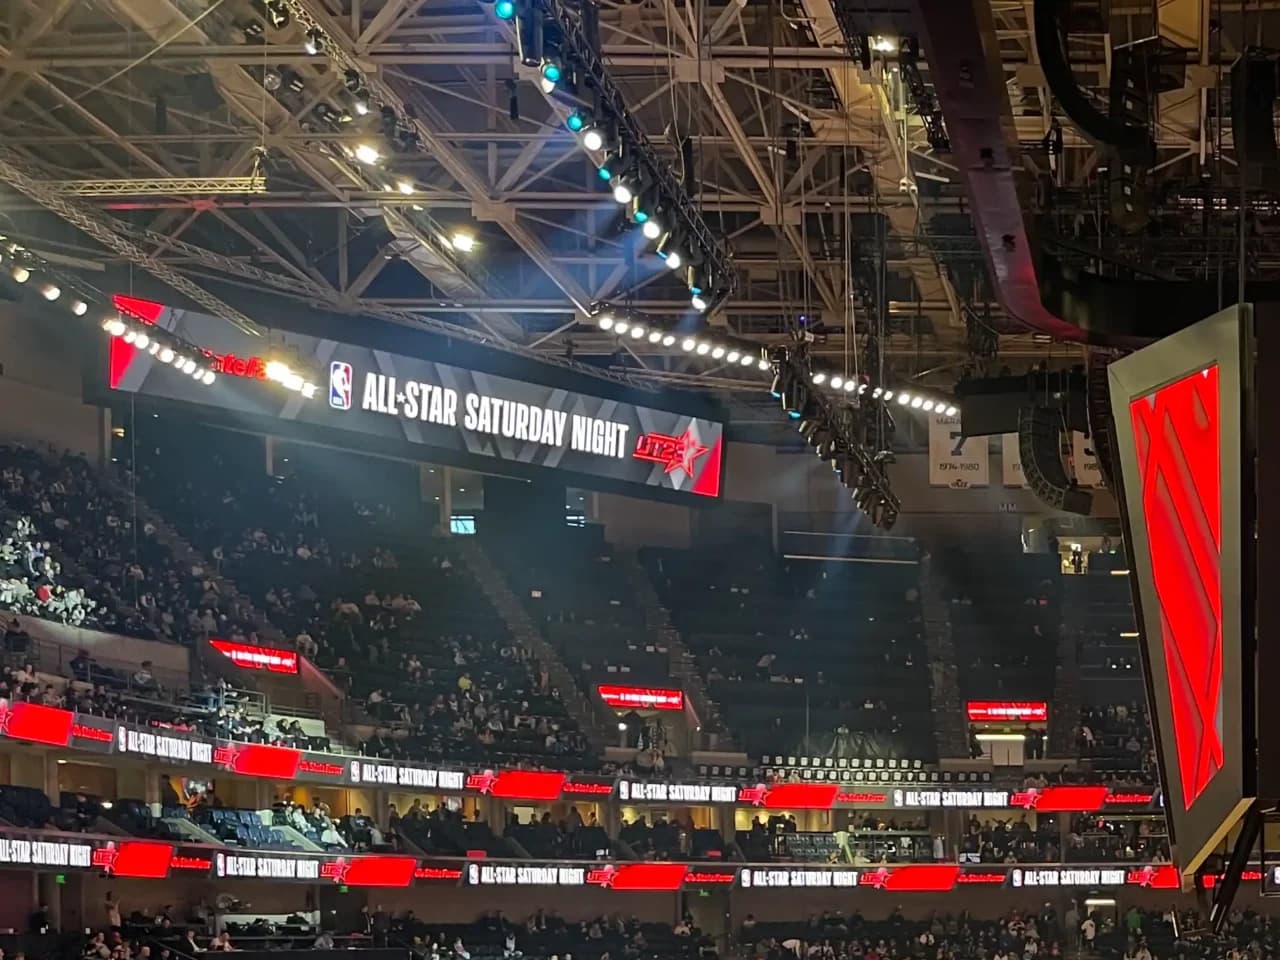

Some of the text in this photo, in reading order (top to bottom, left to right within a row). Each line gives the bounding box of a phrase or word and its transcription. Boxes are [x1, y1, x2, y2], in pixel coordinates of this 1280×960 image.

[465, 393, 567, 446] SATURDAY
[571, 415, 629, 459] NIGHT
[156, 736, 190, 760] SATURDAY
[192, 741, 212, 763] NIGHT
[398, 767, 437, 787] SATURDAY
[438, 770, 464, 789] NIGHT
[669, 785, 711, 800] SATURDAY
[712, 786, 737, 802] NIGHT
[942, 791, 983, 806] SATURDAY
[984, 791, 1008, 807] NIGHT
[32, 841, 68, 866] SATURDAY
[257, 858, 296, 877] SATURDAY
[297, 860, 319, 878] NIGHT
[517, 868, 558, 884] SATURDAY
[559, 868, 584, 885] NIGHT
[790, 871, 831, 886] SATURDAY
[832, 872, 857, 887] NIGHT
[1060, 870, 1100, 885] SATURDAY
[1101, 870, 1125, 884] NIGHT
